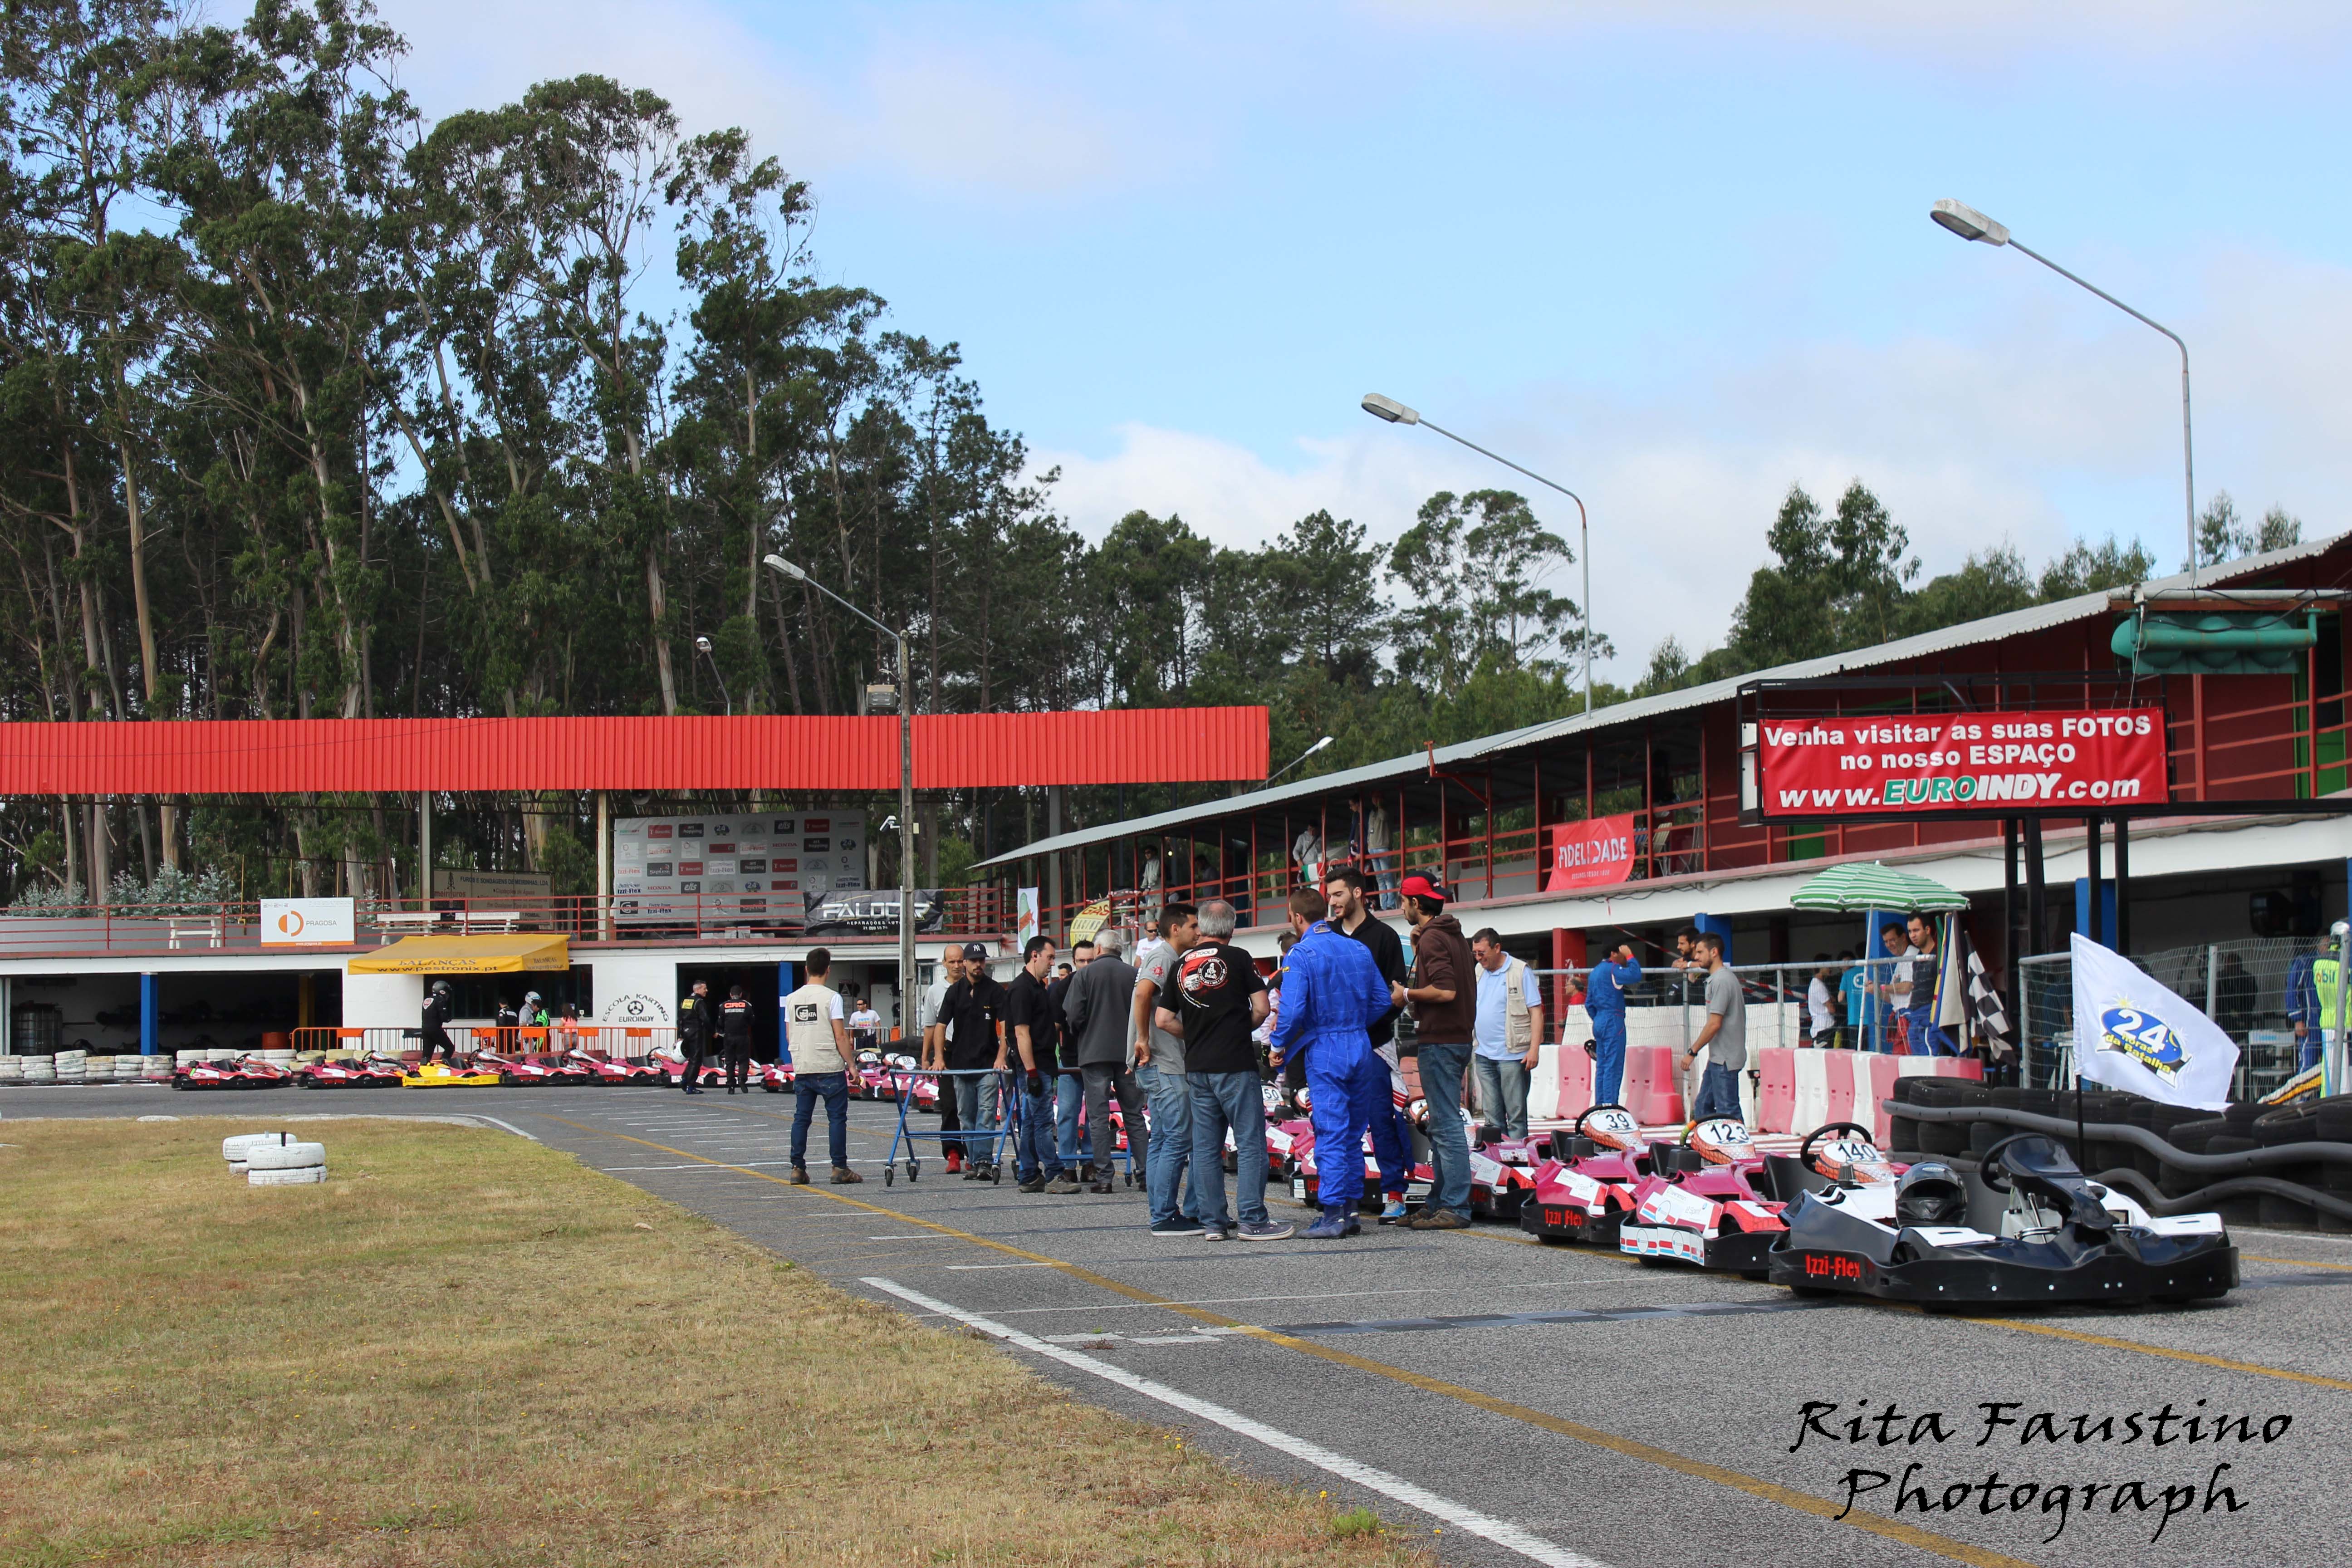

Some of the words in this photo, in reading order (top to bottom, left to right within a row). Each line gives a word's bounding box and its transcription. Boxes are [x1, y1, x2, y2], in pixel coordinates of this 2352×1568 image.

[1764, 726, 1844, 747] Venha
[1854, 724, 1941, 745] visitar
[1951, 723, 1982, 740] as
[1991, 722, 2053, 740] suas
[2062, 715, 2151, 738] FOTOS
[1840, 755, 1872, 770] no
[1882, 750, 1961, 769] nosso
[1969, 743, 2076, 768] ESPAÇO
[1779, 773, 2141, 808] www.EUROINDY.com
[1558, 837, 1628, 869] FIDELIDADE
[822, 902, 930, 919] FALOCR
[603, 995, 630, 1022] ESCOLA
[636, 993, 669, 1022] KARTING
[2111, 1008, 2169, 1054] 24
[2121, 1033, 2154, 1054] horas
[2105, 1034, 2121, 1046] da
[2123, 1043, 2171, 1073] Batalha
[1606, 1113, 1630, 1128] 39
[1710, 1124, 1749, 1141] 123
[1838, 1143, 1877, 1160] 140
[1805, 1254, 1861, 1279] Izzi-Flex
